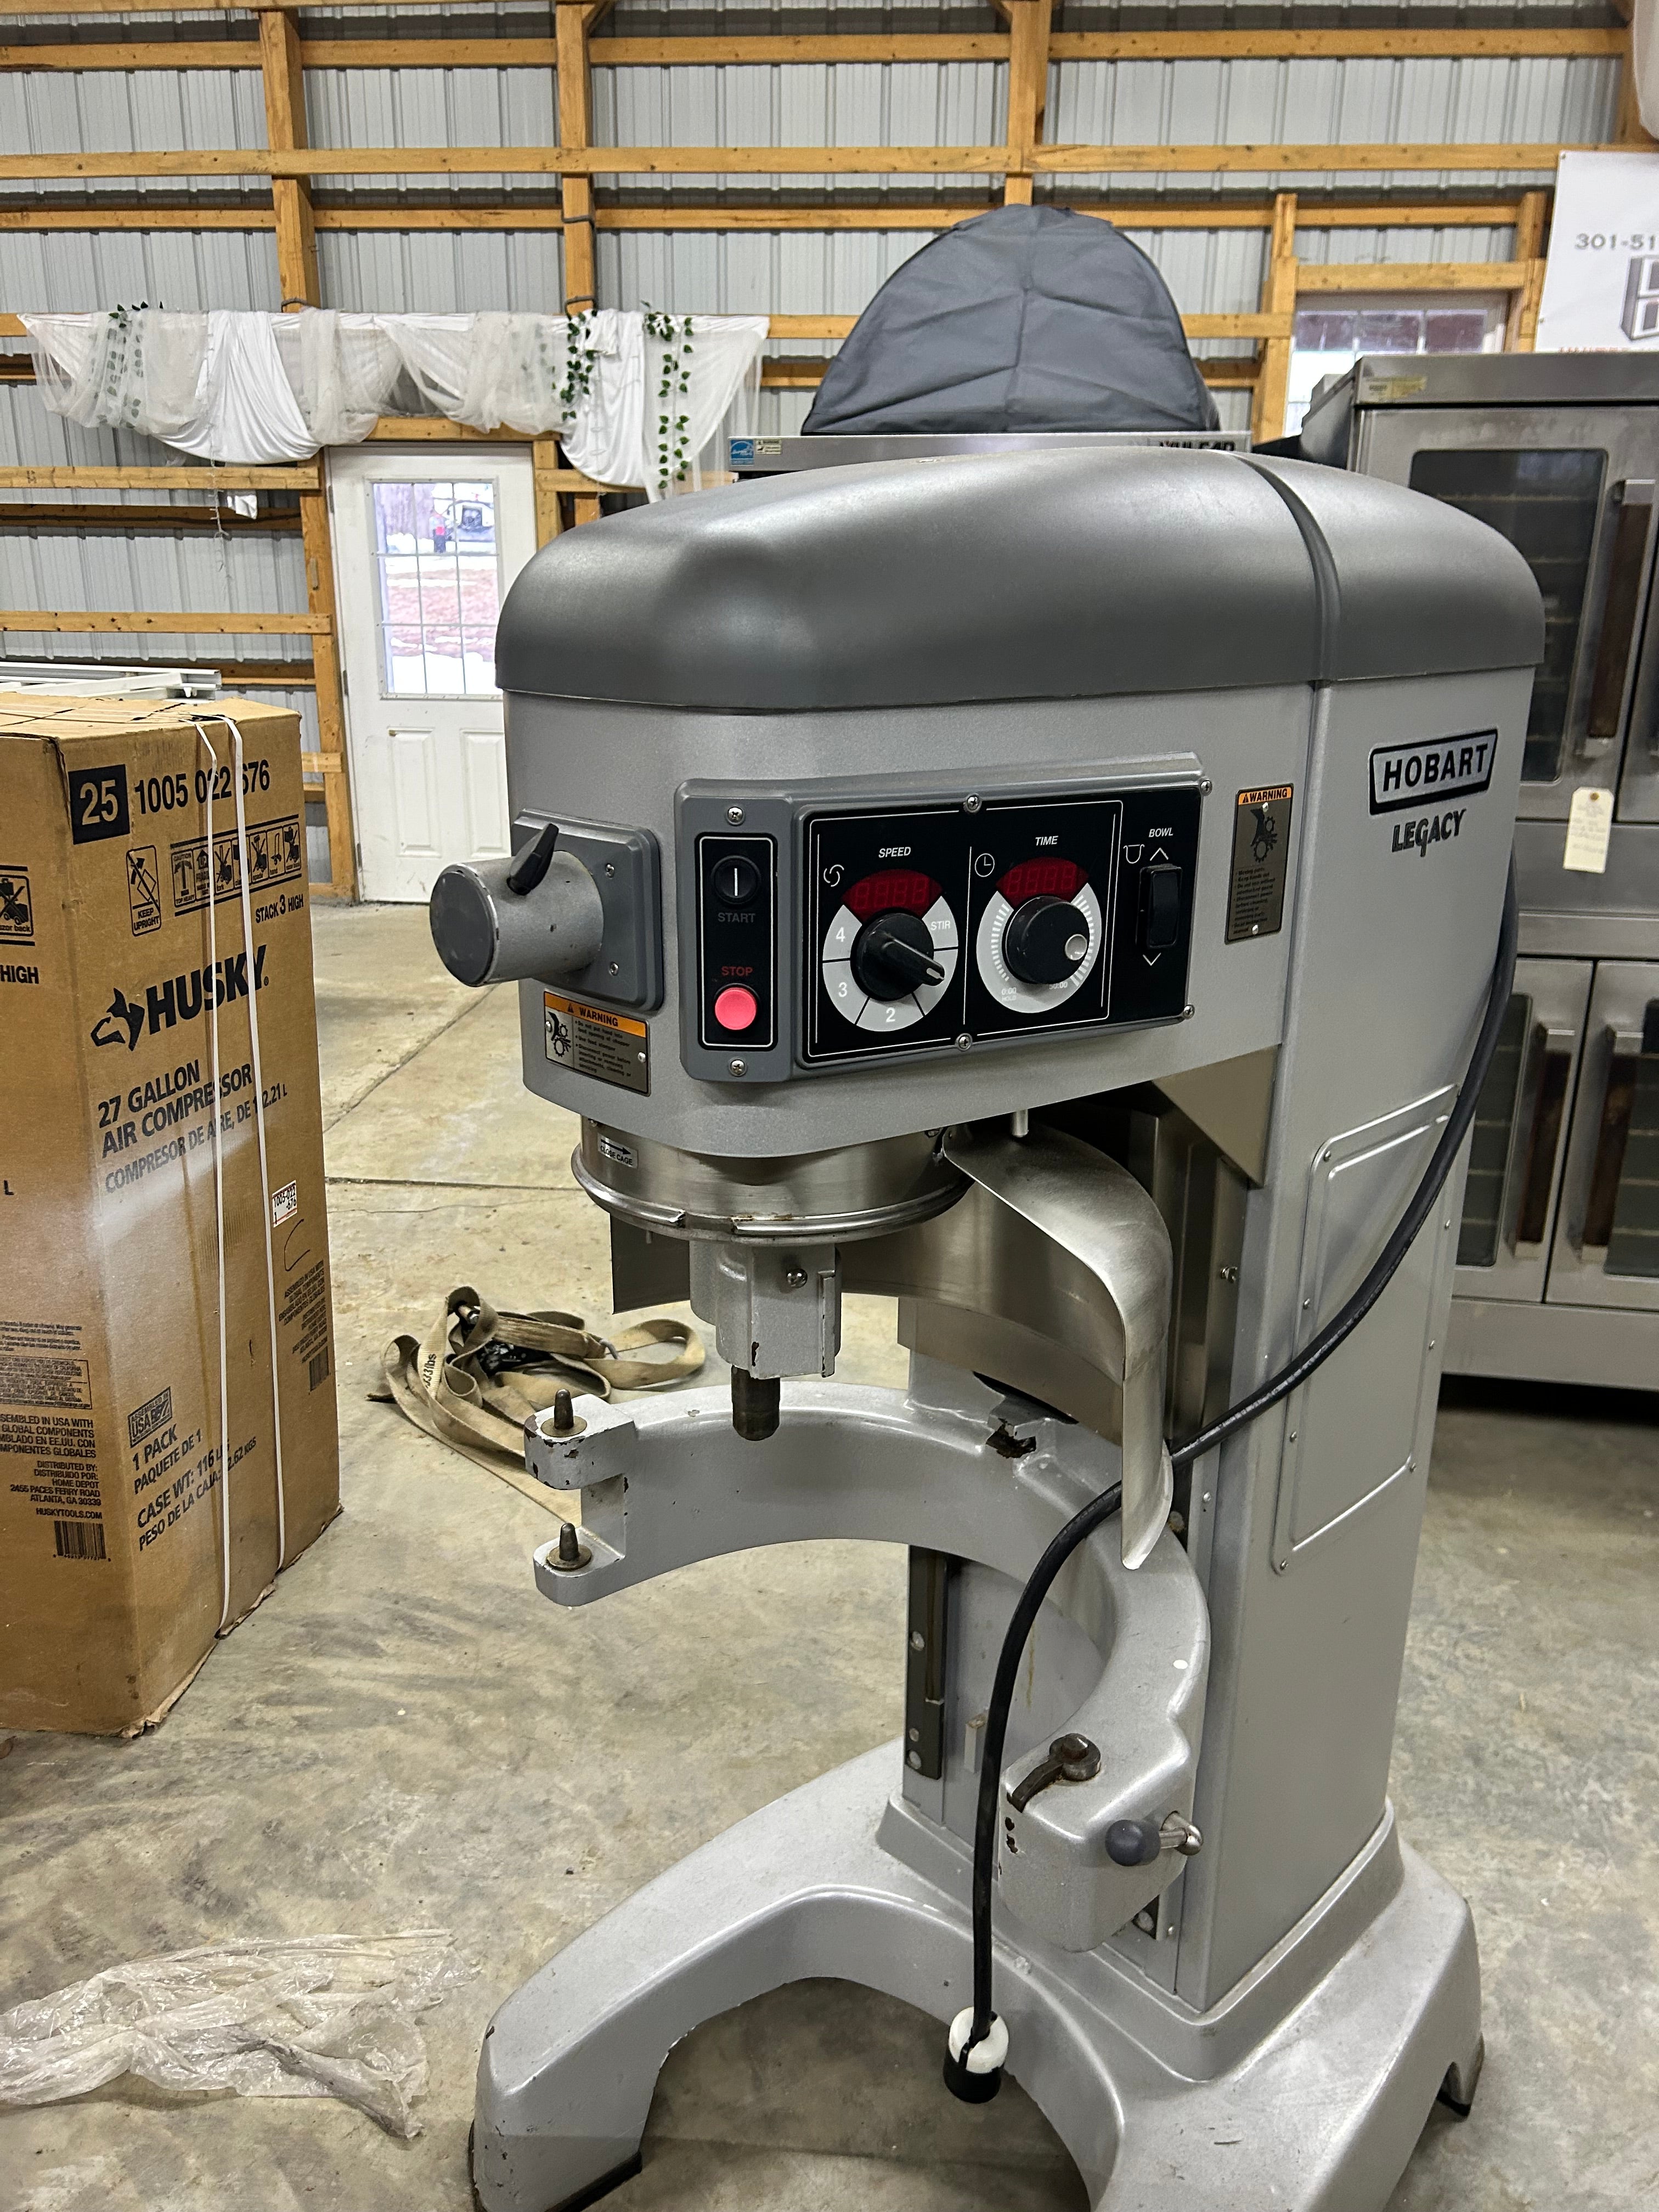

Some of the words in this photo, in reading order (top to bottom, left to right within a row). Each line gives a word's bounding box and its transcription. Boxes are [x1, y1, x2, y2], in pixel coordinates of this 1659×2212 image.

[1383, 743, 1488, 792] HOBART
[134, 773, 188, 814] 1005
[195, 766, 232, 803] 022
[1250, 789, 1287, 802] WARNING
[80, 780, 119, 825] 25
[1149, 827, 1174, 838] BOWL
[1392, 809, 1466, 857] LEGACY
[1035, 836, 1058, 846] TIME
[878, 846, 911, 858] SPEED
[138, 907, 154, 919] KEEP
[256, 906, 278, 923] STACK
[279, 894, 285, 915] 3
[288, 893, 304, 912] HIGH
[134, 916, 159, 930] UPRIGHT
[718, 912, 756, 923] START
[930, 921, 951, 930] STIR
[835, 927, 845, 942] 4
[0, 965, 39, 984] HIGH
[721, 966, 753, 977] STOP
[146, 944, 267, 1035] HUSKY
[838, 982, 847, 997] 3
[579, 1007, 618, 1026] WARNING
[886, 1008, 895, 1022] 2
[98, 1095, 121, 1128] 27
[128, 1059, 200, 1113] GALLON
[102, 1121, 137, 1159] AIR
[105, 1137, 187, 1194] COMPRESOR
[189, 1126, 204, 1150] DE
[207, 1110, 234, 1140] ARE,
[236, 1101, 251, 1123] DE
[253, 1083, 281, 1114] 12.21
[283, 1084, 287, 1097] L
[617, 1154, 633, 1166] CAGE
[42, 1417, 50, 1425] IN
[53, 1417, 70, 1426] USA
[71, 1418, 93, 1428] WITH
[132, 1414, 151, 1437] USA
[2, 1424, 35, 1434] GLOBAL
[36, 1426, 94, 1438] COMPONENTS
[36, 1436, 47, 1444] EN
[77, 1438, 95, 1448] CON
[133, 1453, 139, 1471] 1
[144, 1424, 178, 1464] PACK
[53, 1447, 97, 1458] GLOBALES
[37, 1460, 84, 1471] DISTRIBUTED
[134, 1446, 180, 1495] PAQUETE
[182, 1434, 195, 1456] DE
[196, 1428, 201, 1442] 1
[34, 1469, 80, 1479] DISTRIBUIDO
[81, 1472, 98, 1480] POR:
[30, 1485, 54, 1494] PACES
[55, 1487, 78, 1496] FERRY
[80, 1488, 100, 1497] ROAD
[52, 1479, 74, 1487] HOME
[75, 1481, 99, 1489] DEPOT
[137, 1488, 171, 1528] CASE
[172, 1469, 194, 1499] WT:
[197, 1449, 215, 1477] 116
[30, 1494, 65, 1505] ATLANTA,
[66, 1496, 77, 1505] GA
[139, 1519, 165, 1551] PESO
[167, 1504, 181, 1527] DE
[182, 1495, 195, 1513] LA
[227, 1446, 244, 1471] 2.62
[36, 1507, 103, 1519] HUSKYTOOLS.COM
